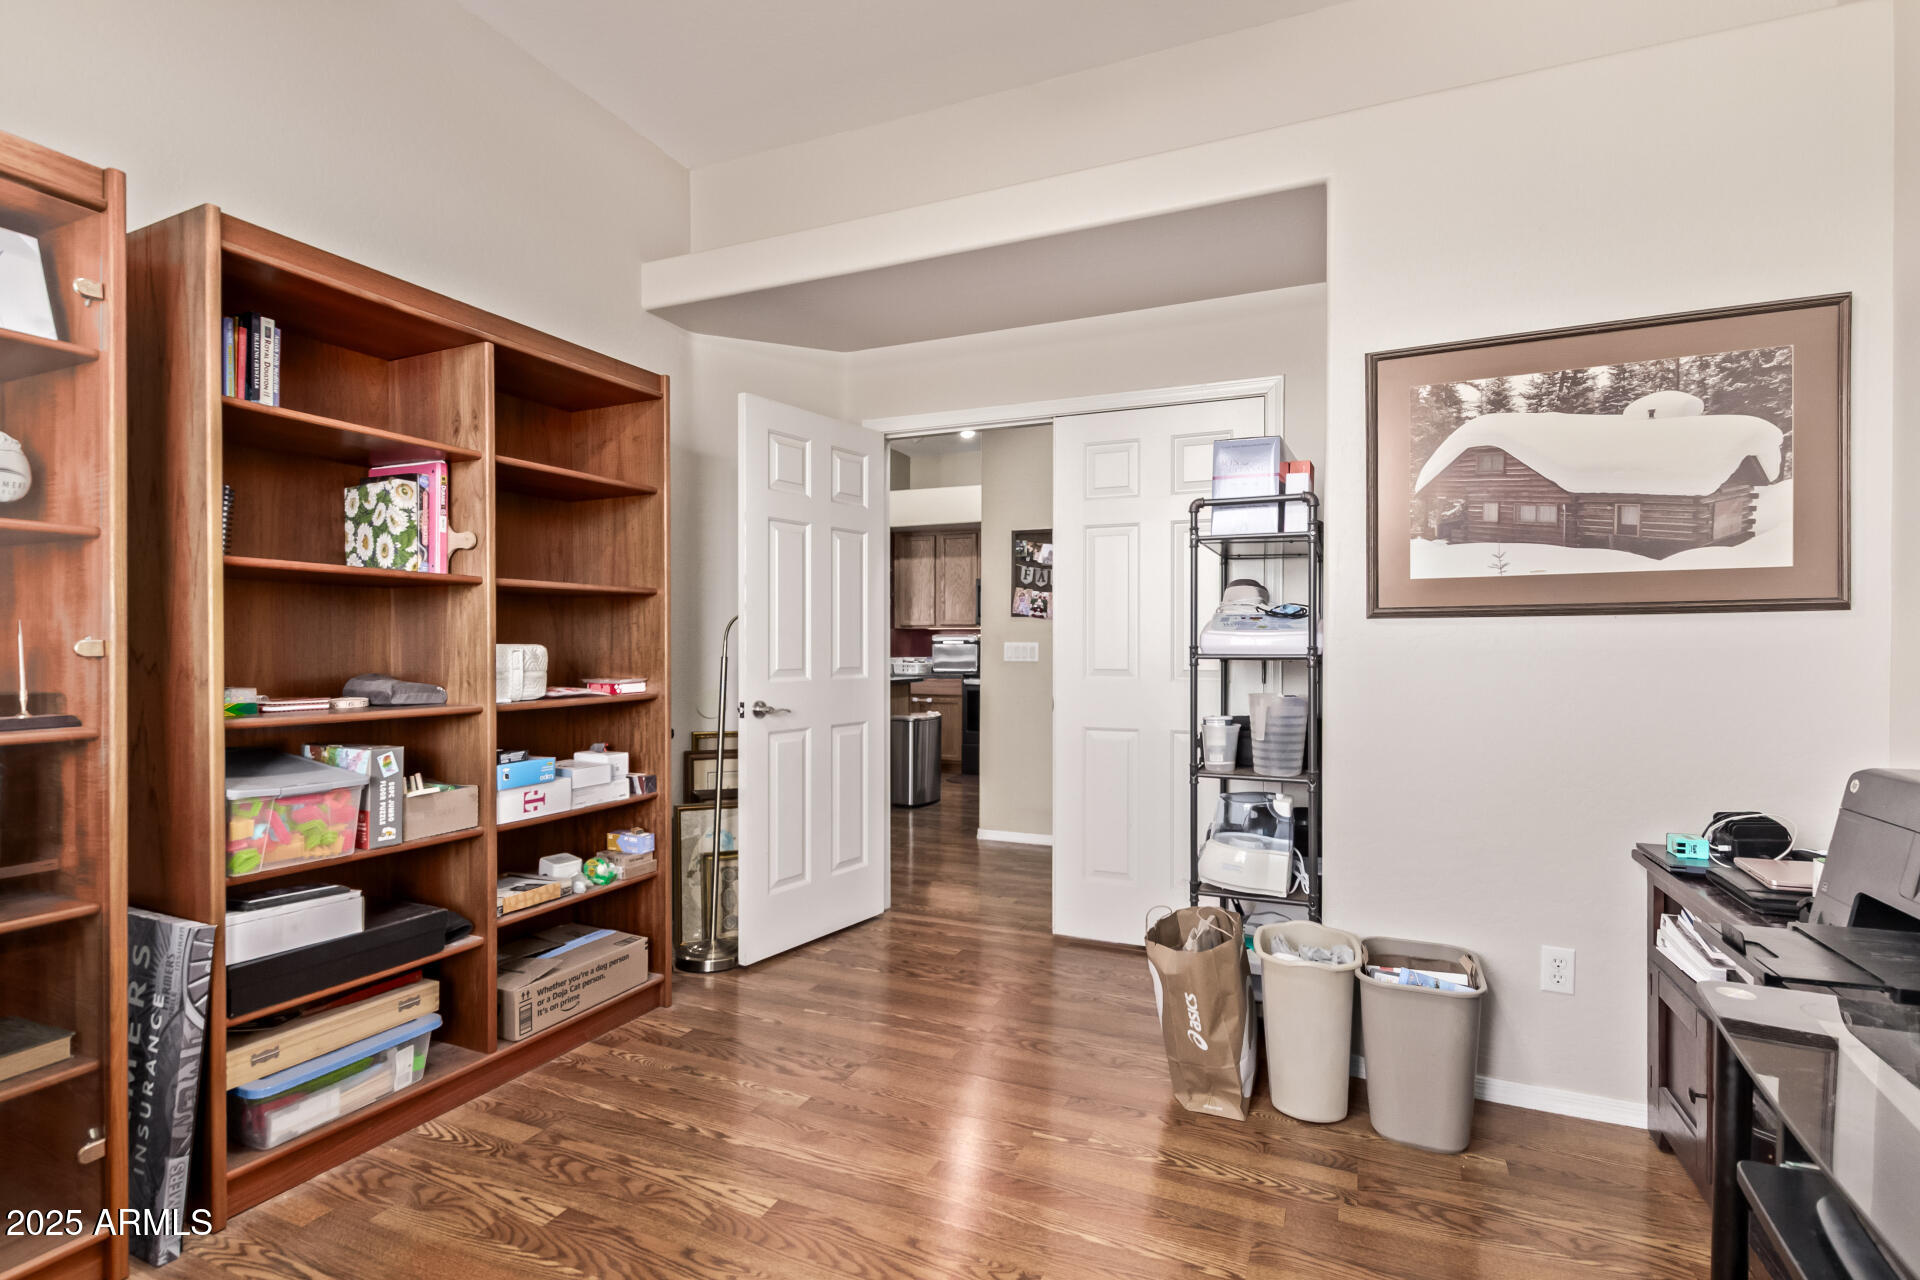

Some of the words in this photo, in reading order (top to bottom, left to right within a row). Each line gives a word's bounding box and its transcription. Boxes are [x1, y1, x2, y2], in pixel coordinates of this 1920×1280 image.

[379, 780, 387, 801] FLOOR
[379, 801, 387, 826] PUZZLE
[537, 978, 567, 996] Whether
[568, 970, 589, 985] you're
[595, 962, 608, 973] dog
[608, 954, 630, 969] person
[537, 999, 545, 1007] or
[552, 989, 568, 1001] Doja
[569, 983, 581, 993] Cat
[582, 973, 606, 989] person.
[537, 1007, 548, 1017] It's
[549, 1003, 559, 1012] on
[560, 994, 580, 1009] prime
[133, 992, 166, 1176] INSURANCE
